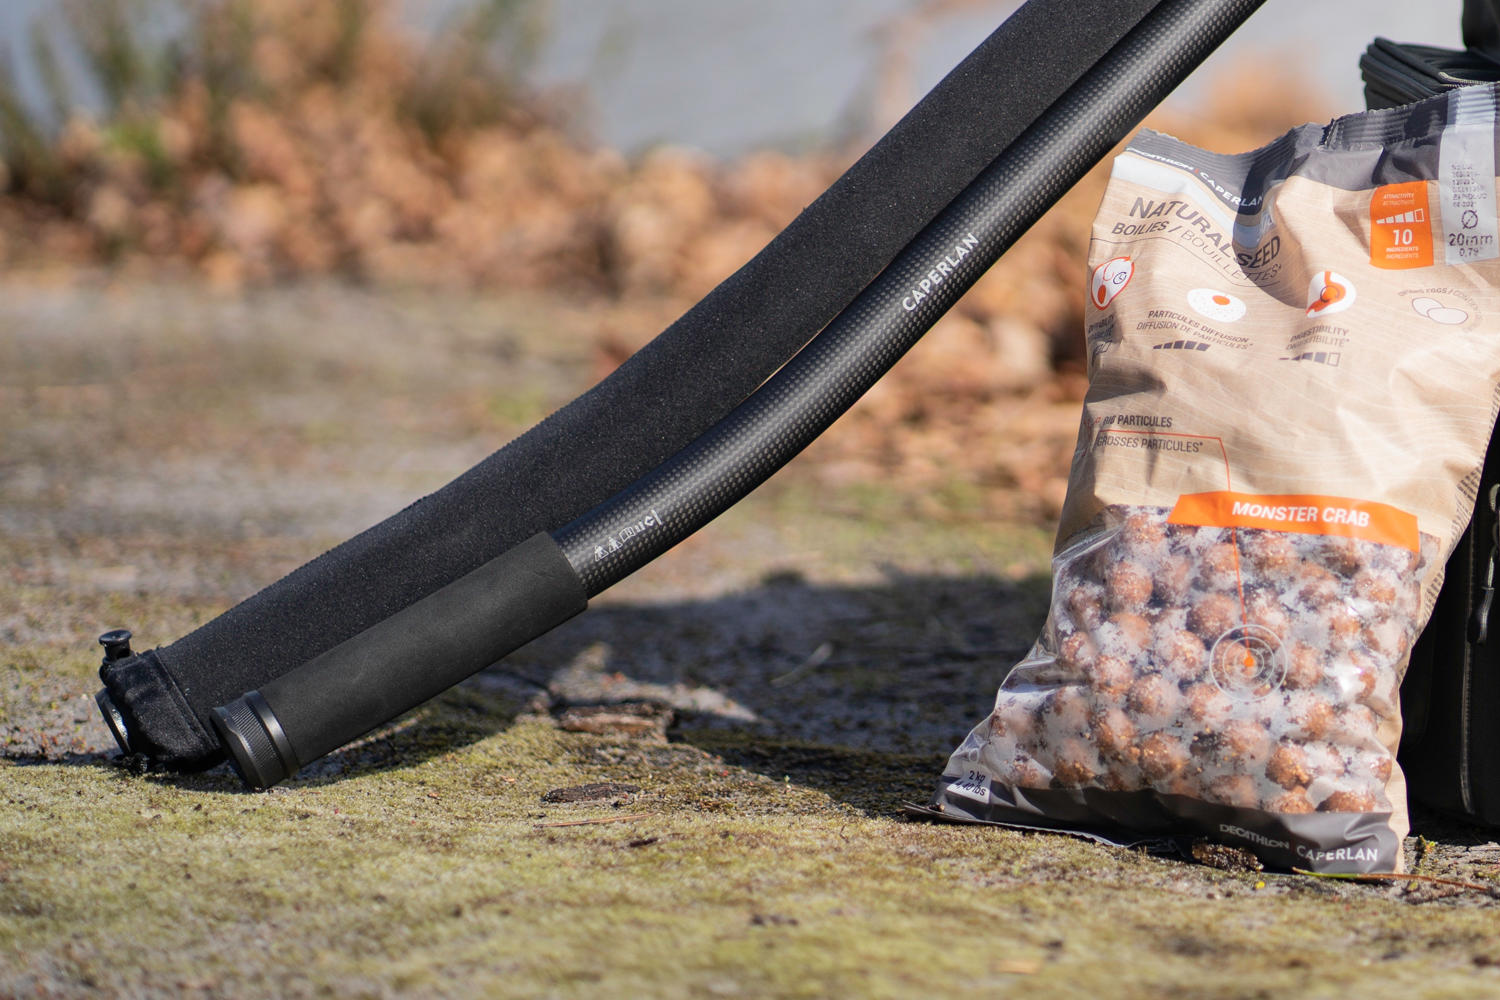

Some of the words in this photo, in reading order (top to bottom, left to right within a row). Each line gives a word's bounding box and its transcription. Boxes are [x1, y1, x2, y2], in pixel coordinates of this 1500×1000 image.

[1112, 221, 1169, 235] BOILIES
[1168, 225, 1182, 233] /
[1129, 197, 1233, 258] NATURAL
[1236, 236, 1281, 269] SEED
[1393, 229, 1412, 245] 10
[1448, 233, 1493, 246] 20mm
[902, 233, 979, 311] CAPERLAN
[1136, 321, 1178, 330] DIFFUSION
[1180, 325, 1191, 333] DE
[1148, 310, 1200, 328] PARTICULES
[1201, 326, 1249, 343] DIFFUSION
[1117, 415, 1173, 427] PARTICULES
[1232, 501, 1318, 522] MONSTER
[1322, 508, 1370, 528] CRAB
[969, 770, 975, 780] 2
[975, 771, 986, 784] kg
[972, 783, 986, 796] lbs
[1219, 824, 1290, 849] DECATHLON
[1297, 846, 1378, 861] CAPERLAN
